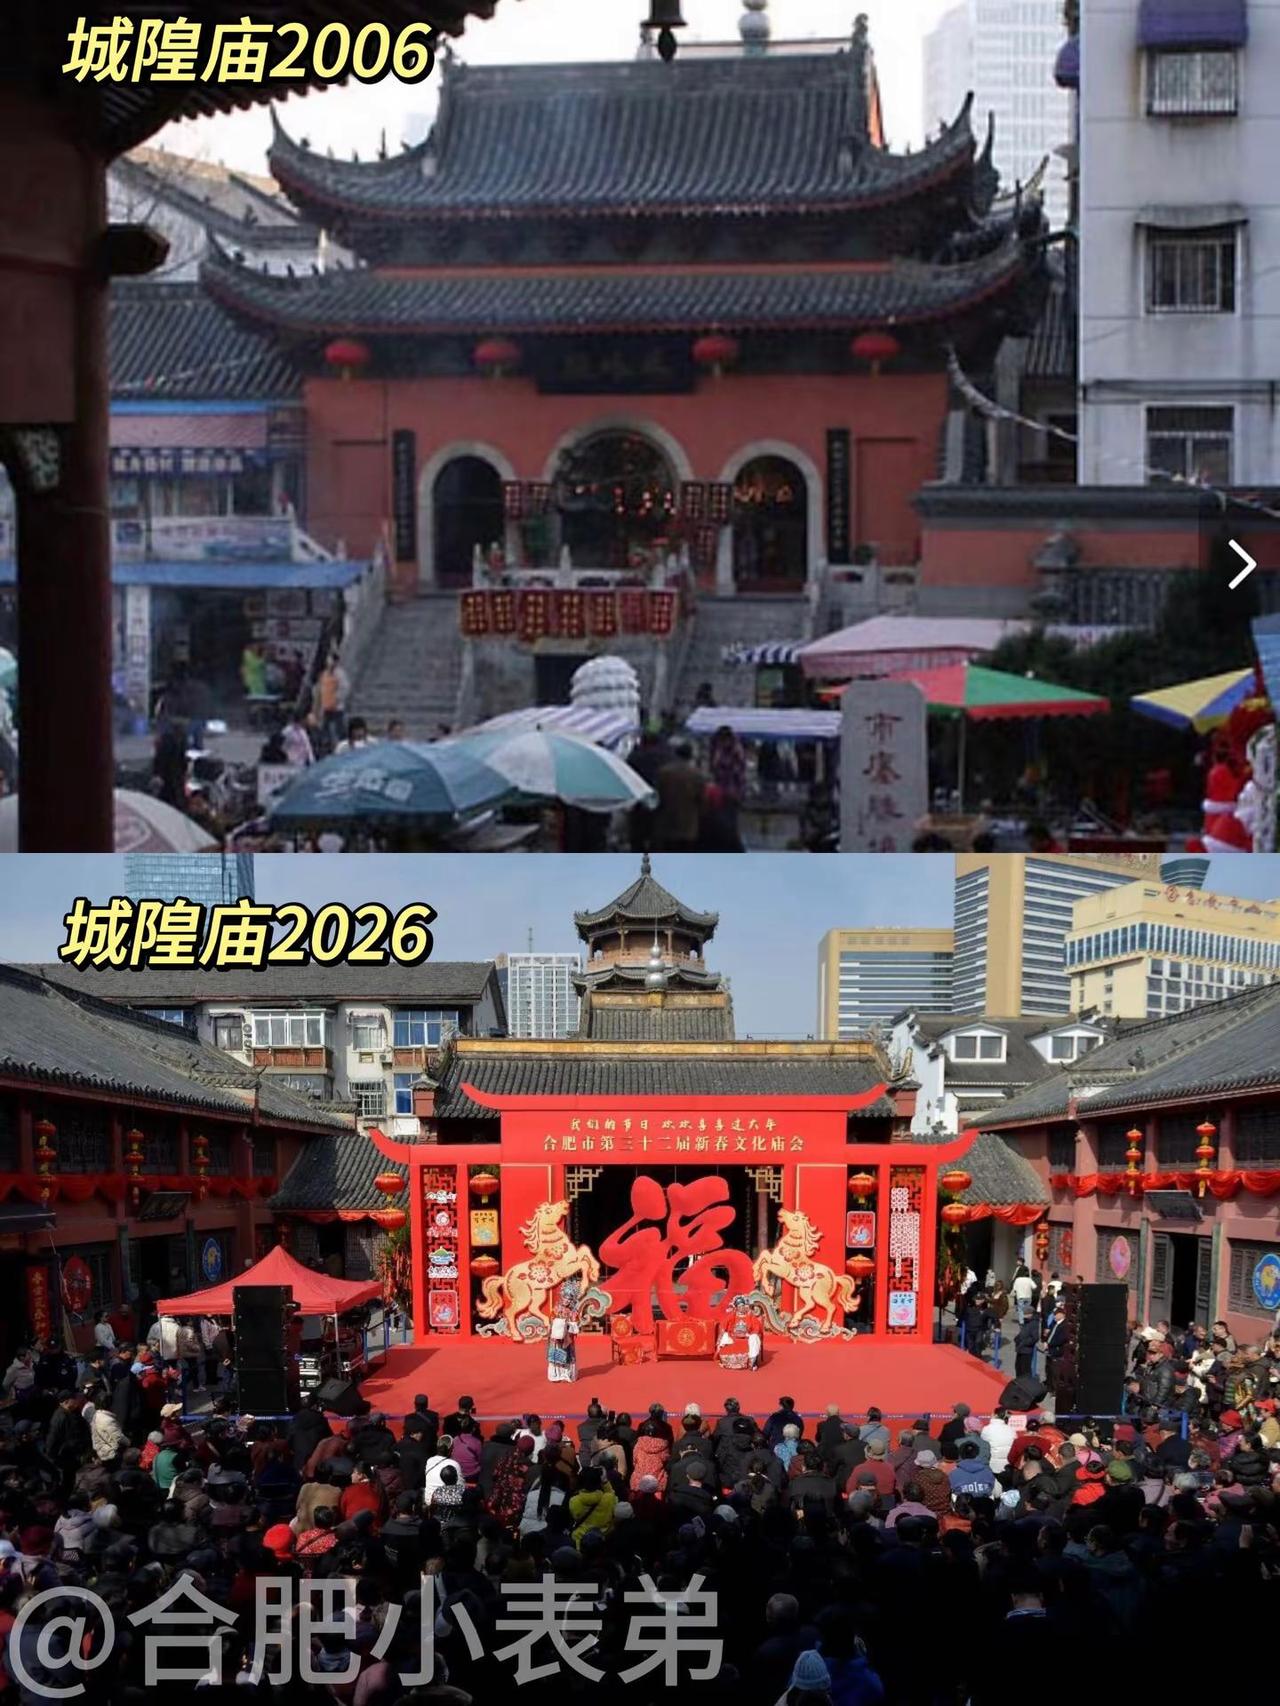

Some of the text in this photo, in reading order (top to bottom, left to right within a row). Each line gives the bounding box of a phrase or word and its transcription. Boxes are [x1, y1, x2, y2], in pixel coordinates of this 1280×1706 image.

[570, 1117, 778, 1131] 我们的节日 欢欢喜喜过大年
[543, 1134, 805, 1152] 合肥市第三十二届新春文化庙会
[598, 1175, 757, 1331] 福
